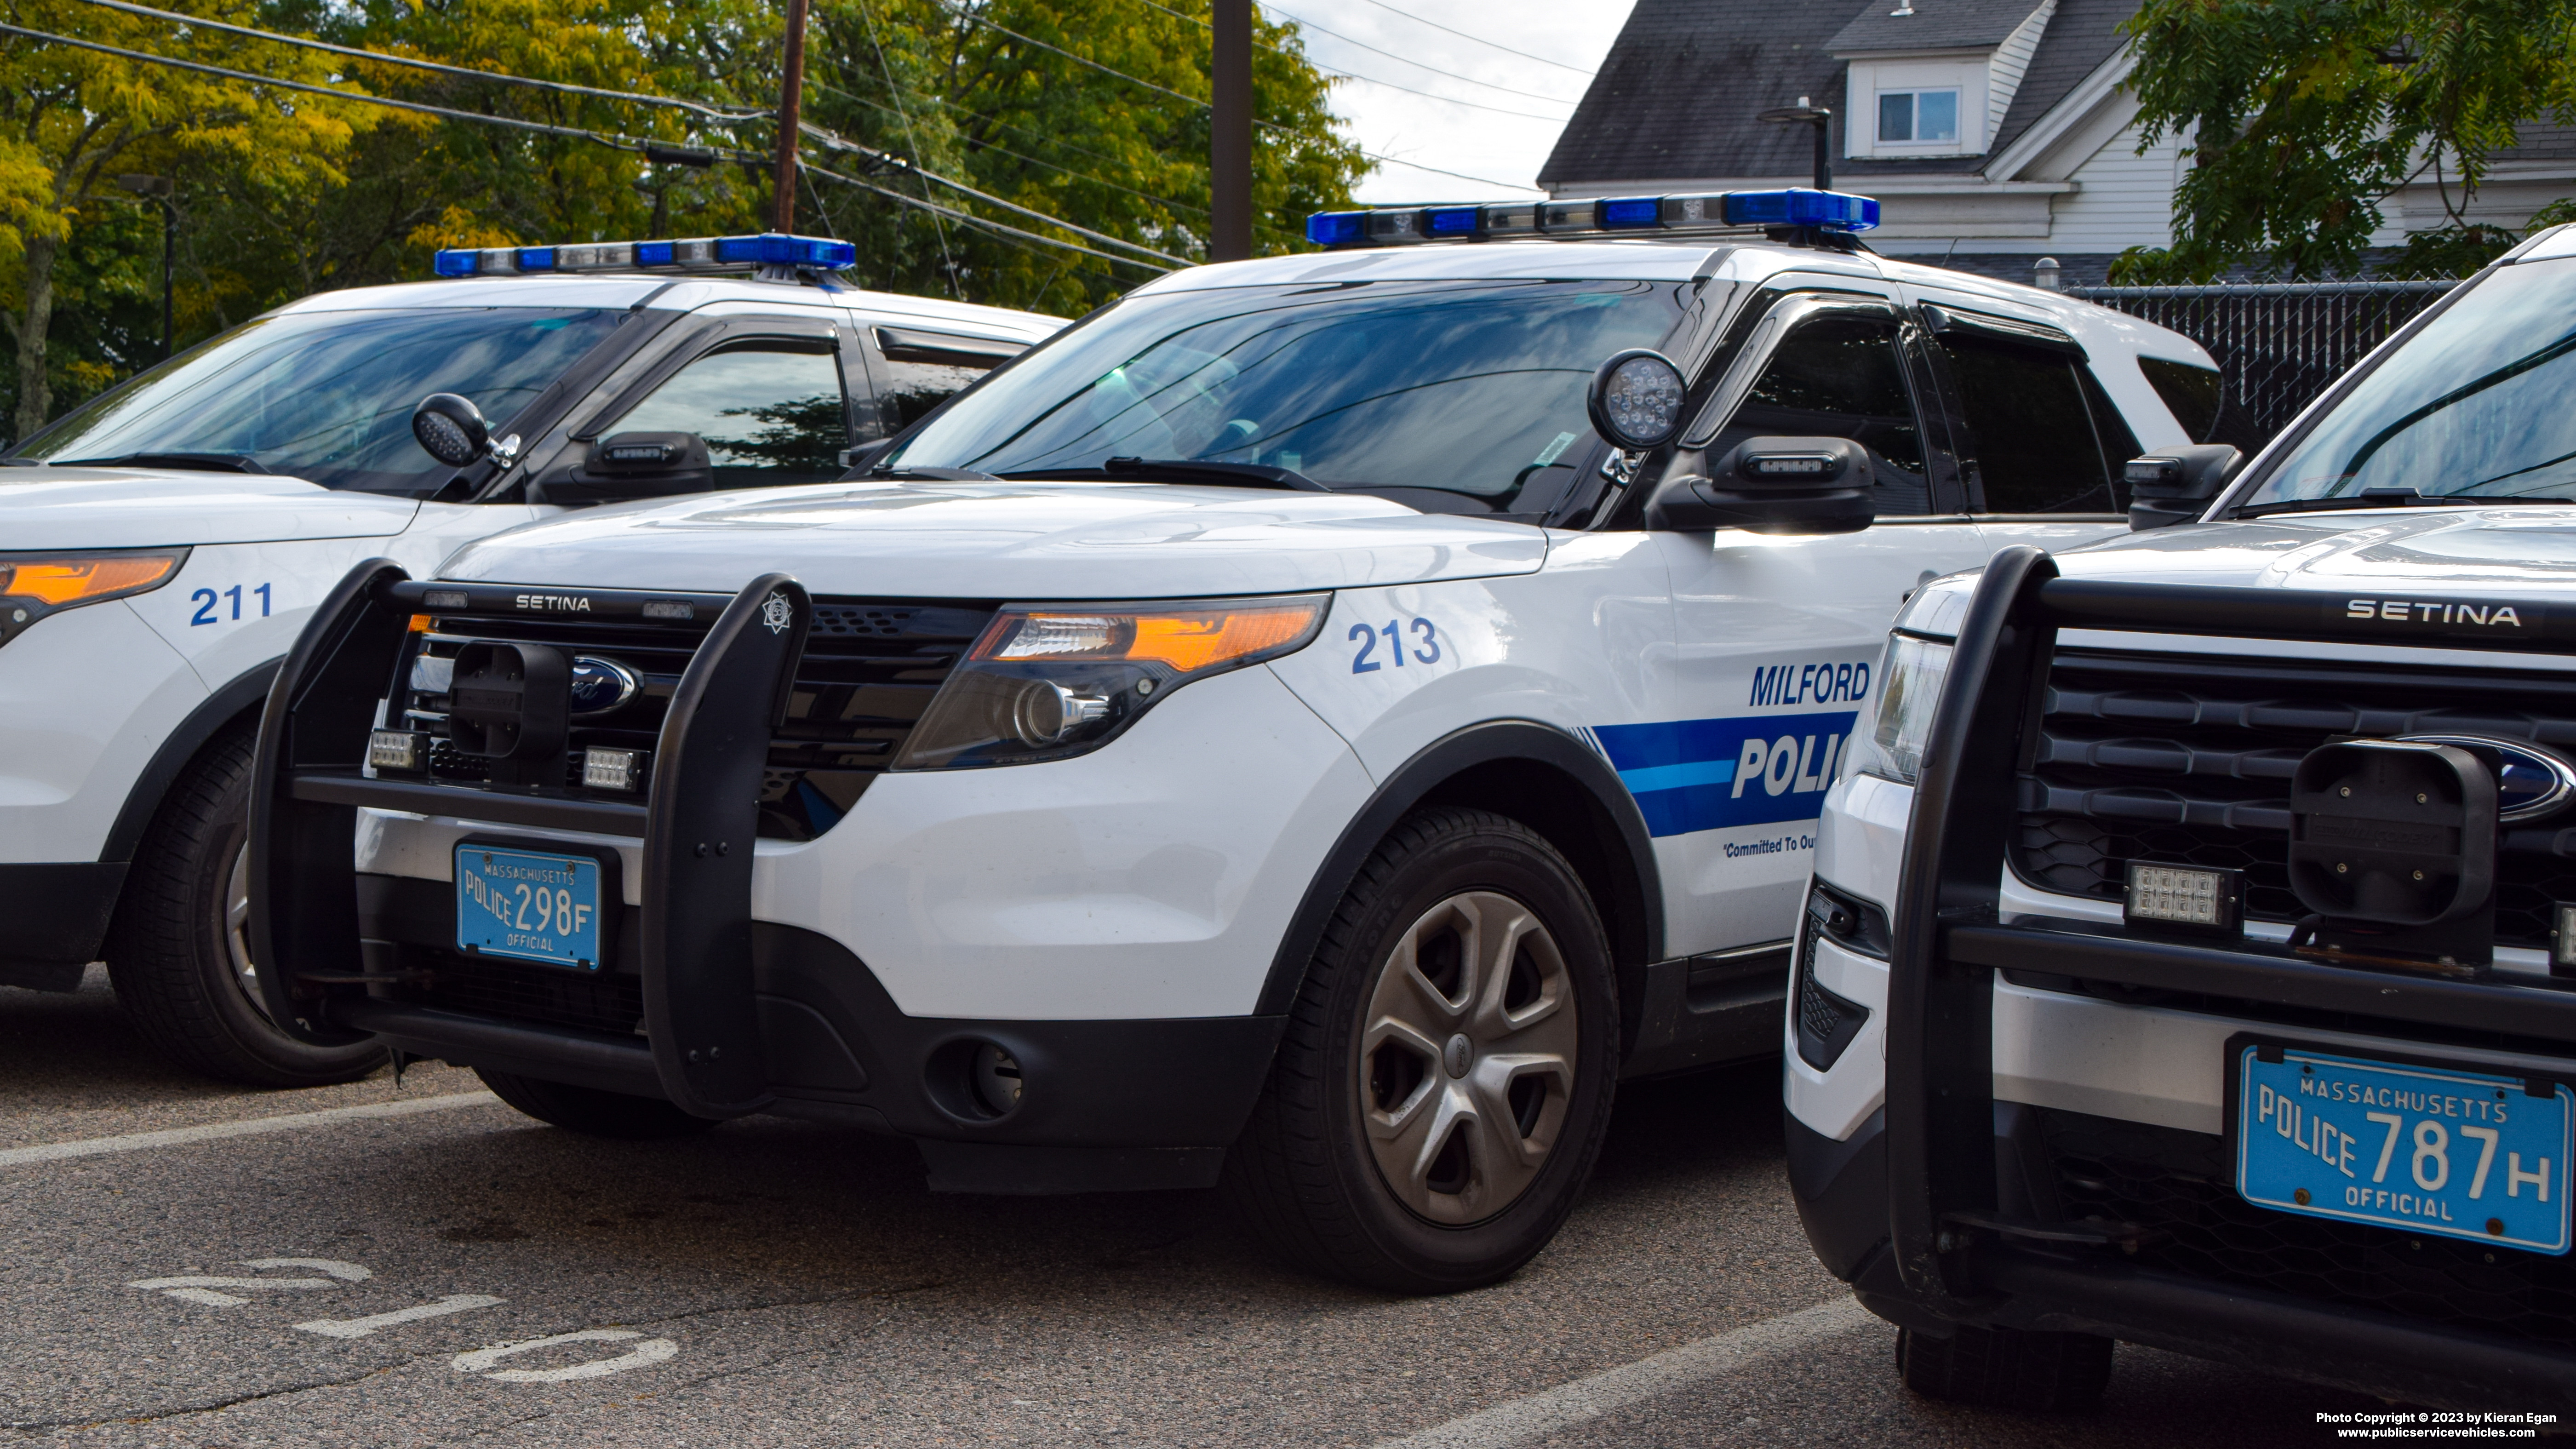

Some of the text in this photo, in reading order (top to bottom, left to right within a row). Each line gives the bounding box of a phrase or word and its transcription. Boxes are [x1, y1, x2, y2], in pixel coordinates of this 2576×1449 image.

[190, 582, 271, 626] 211
[516, 594, 591, 612] SETINA
[2347, 599, 2520, 627] SETINA
[1348, 617, 1440, 674] 213
[1750, 662, 1870, 707] MILFORD
[1723, 835, 1816, 858] "Committed To Ou
[485, 865, 575, 886] MASSACHUSETTS
[465, 869, 592, 937] POLICE 298F
[507, 933, 554, 952] OFFICIAL
[2301, 1077, 2508, 1123] MASSACHUSETTS
[2258, 1083, 2551, 1203] POLICE 787H
[2346, 1186, 2453, 1221] OFFICIAL
[127, 1257, 679, 1382] 210
